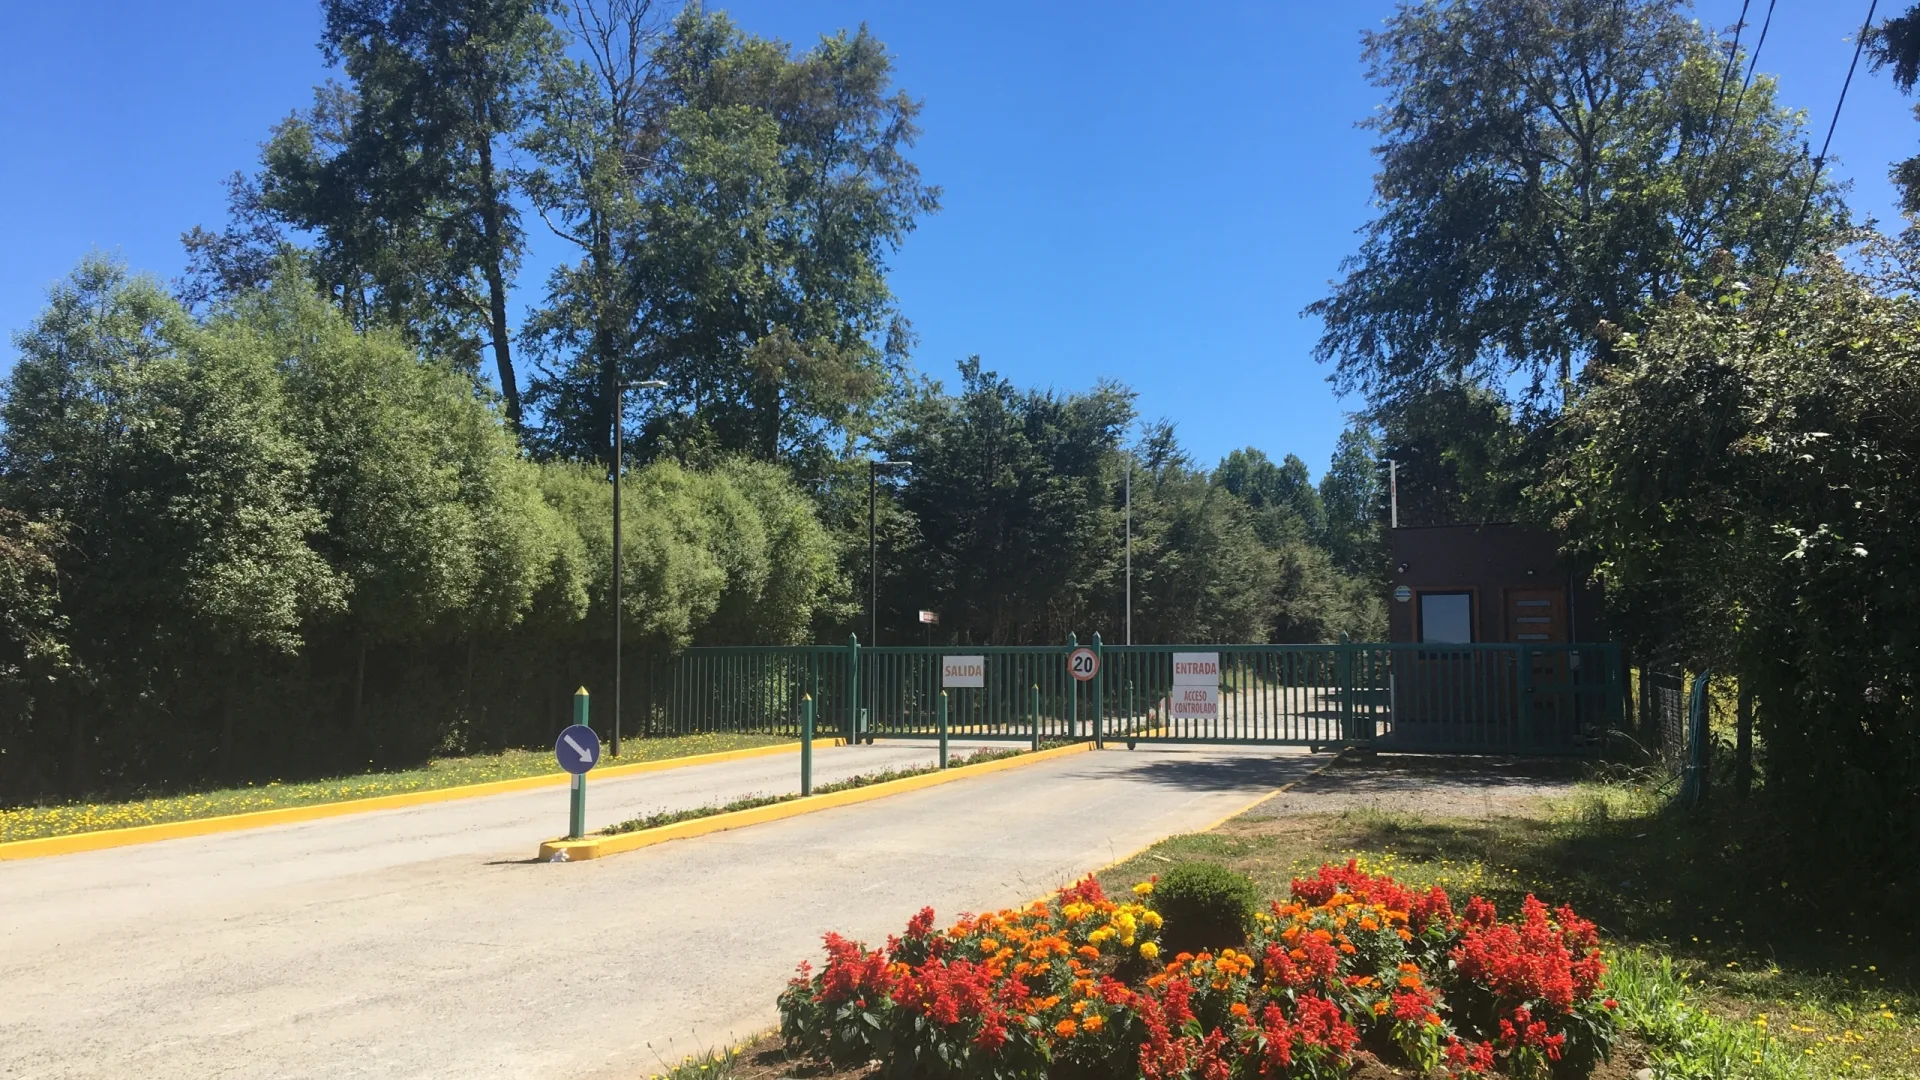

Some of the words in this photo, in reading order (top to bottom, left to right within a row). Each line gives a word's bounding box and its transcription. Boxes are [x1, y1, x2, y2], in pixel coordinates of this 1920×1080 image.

[1073, 656, 1093, 673] 20
[1175, 662, 1217, 675] ENTRADA
[945, 665, 982, 677] SALIDA
[1184, 690, 1207, 702] ACCESO
[1175, 702, 1217, 714] CONTROLADO
